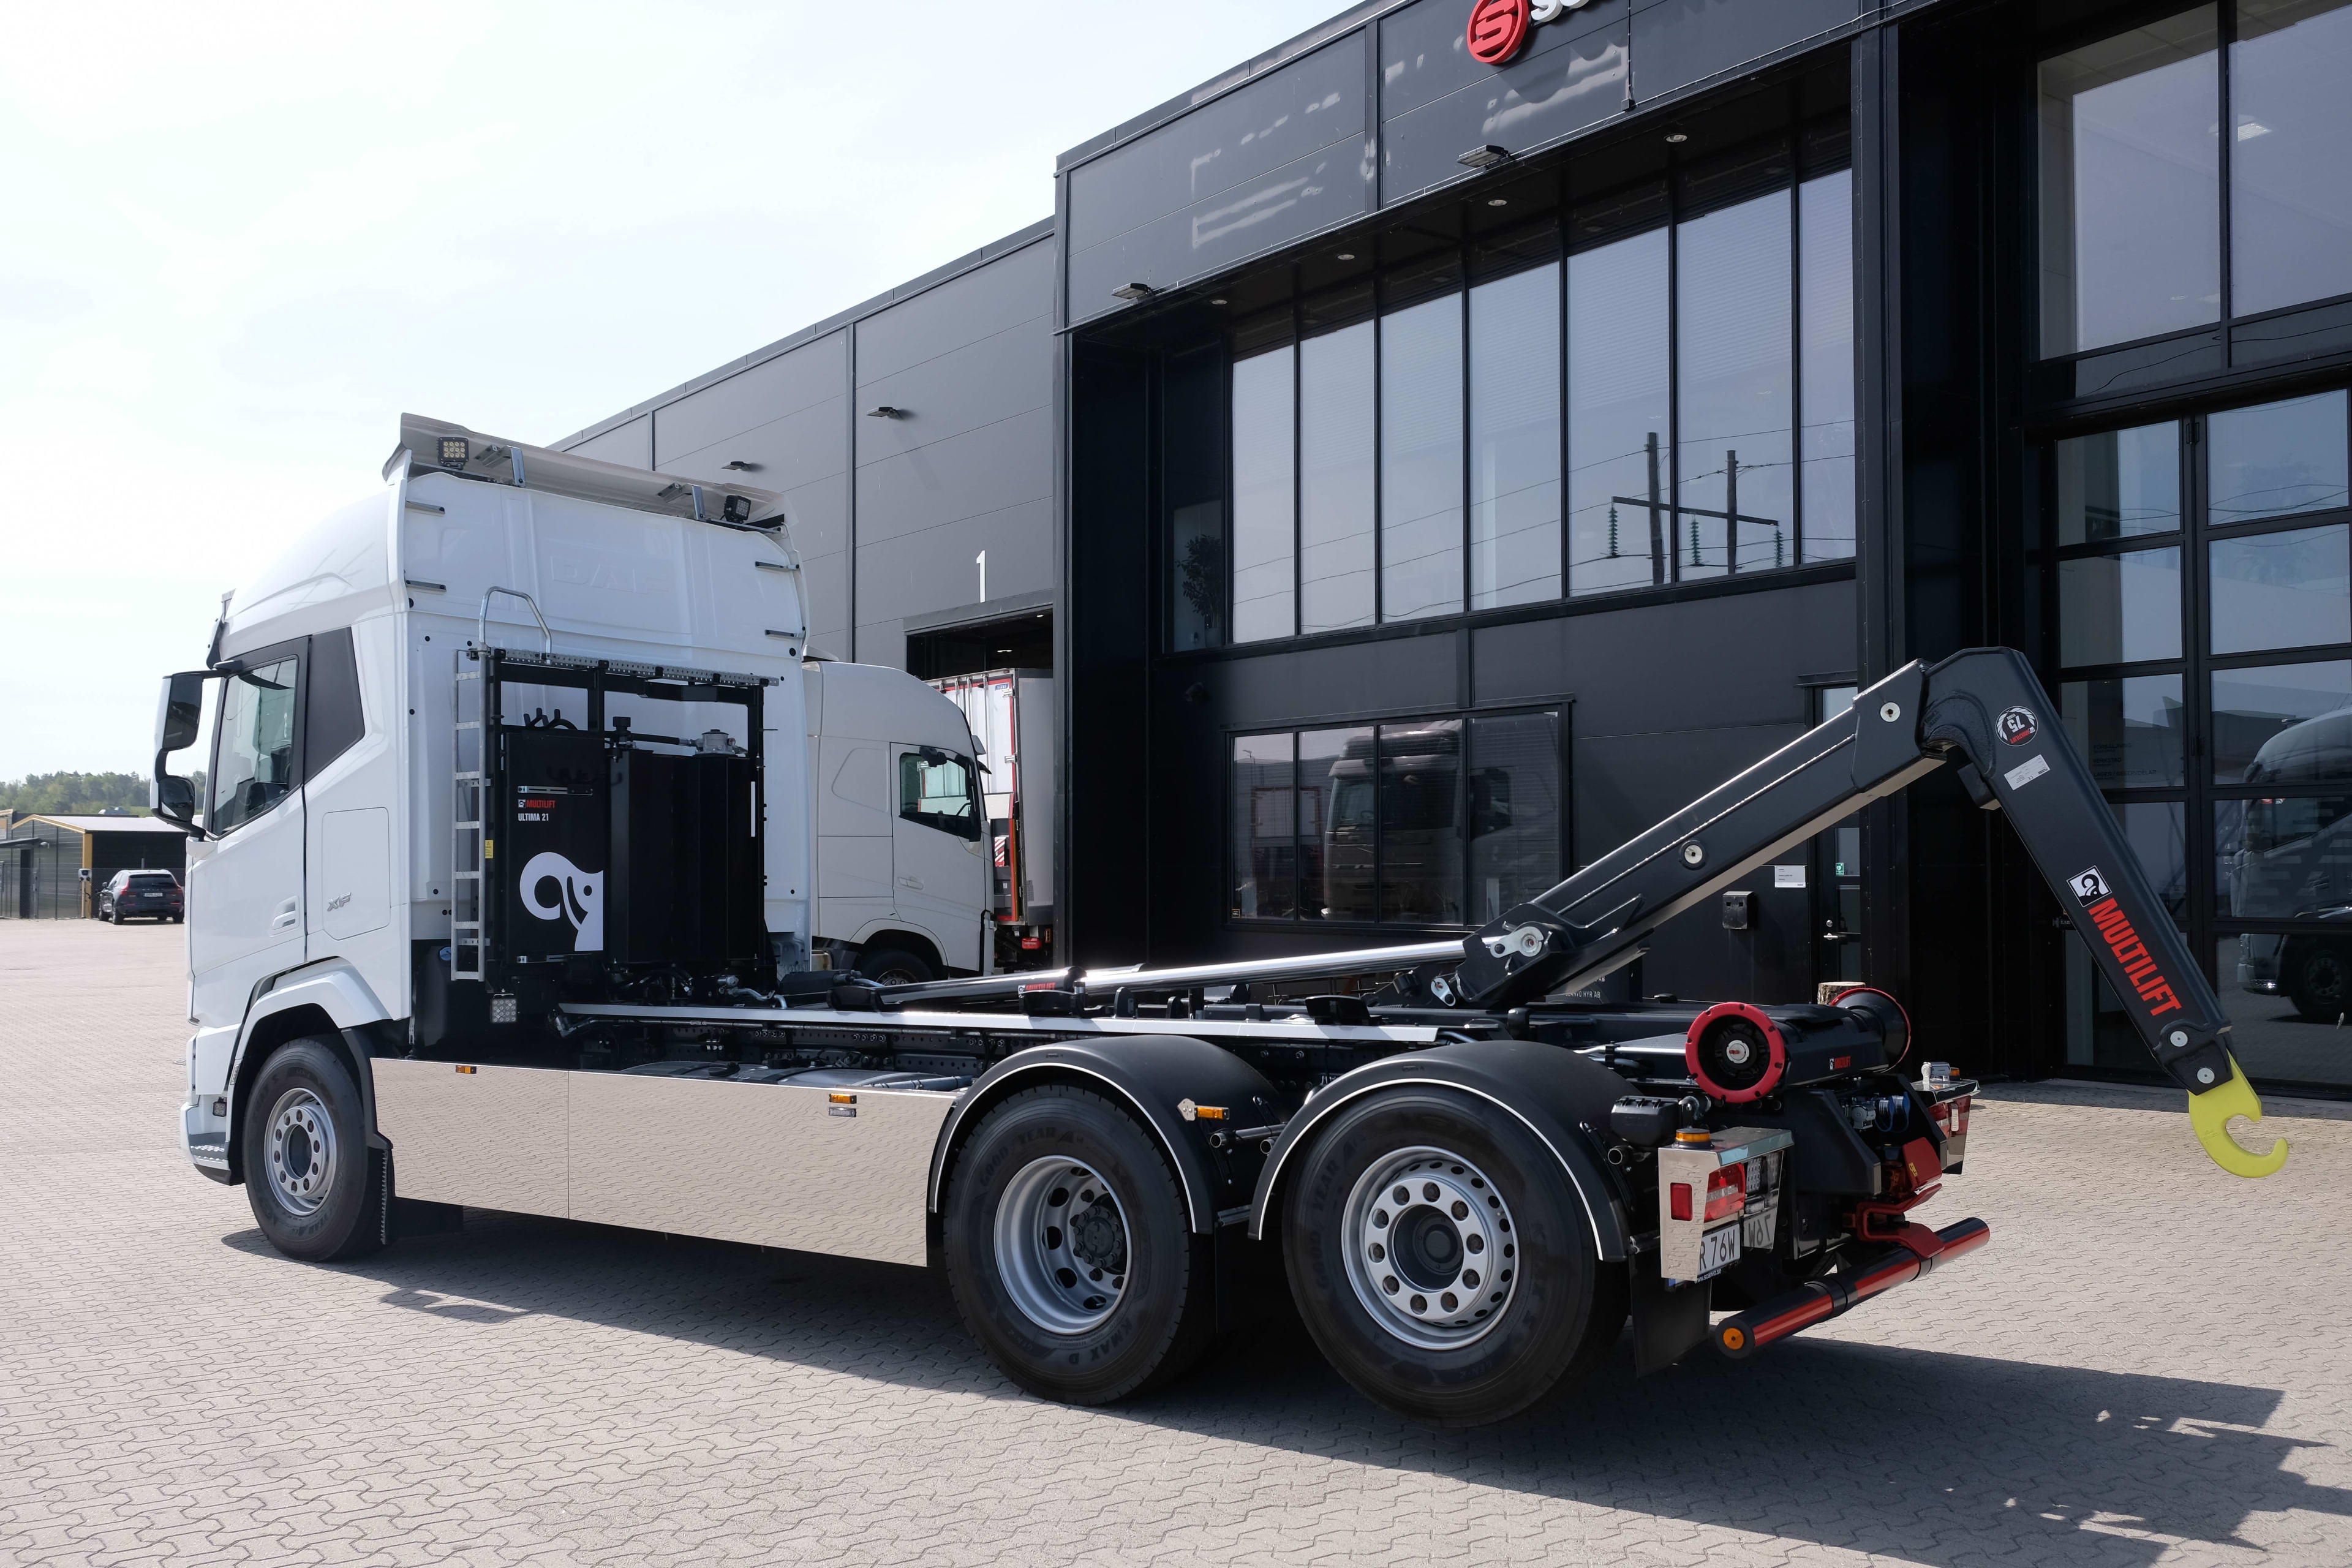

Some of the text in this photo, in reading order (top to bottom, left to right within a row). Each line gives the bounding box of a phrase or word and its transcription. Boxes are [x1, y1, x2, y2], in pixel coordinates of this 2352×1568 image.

[2007, 715, 2026, 733] 75
[527, 799, 556, 809] MULTILIFT
[518, 813, 549, 821] ULTIMA 21
[326, 891, 352, 912] XF
[2088, 897, 2182, 1017] MULTILIFT
[1710, 1229, 1735, 1266] 76W
